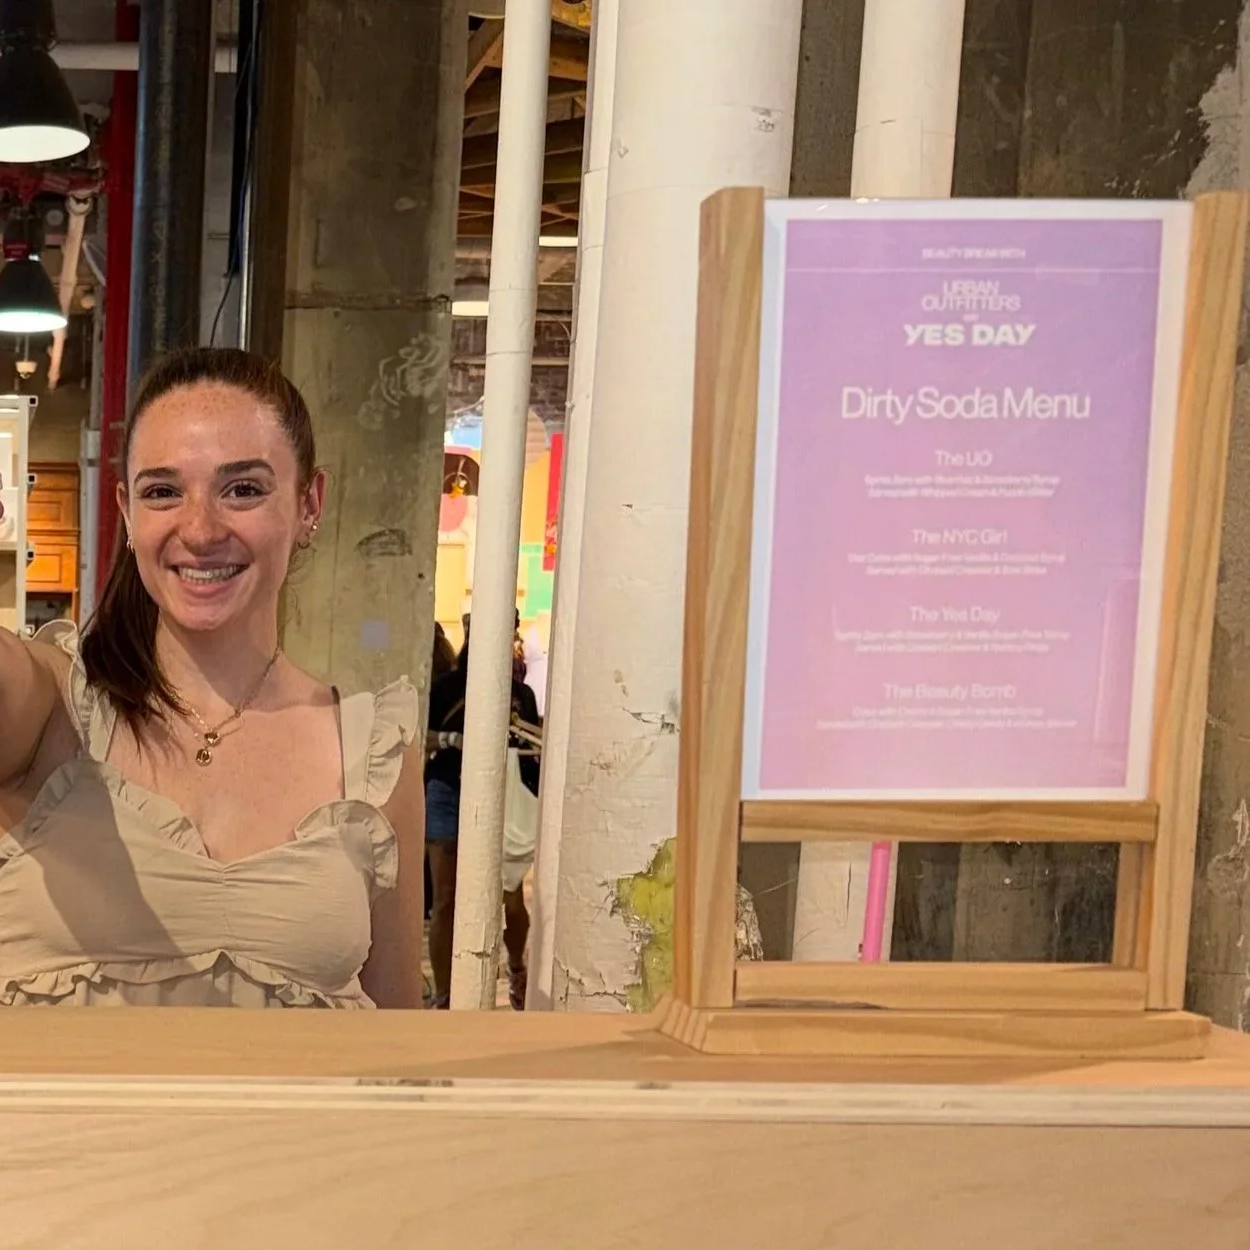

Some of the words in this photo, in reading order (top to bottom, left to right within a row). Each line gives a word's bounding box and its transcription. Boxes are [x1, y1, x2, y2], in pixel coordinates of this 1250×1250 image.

[943, 279, 1001, 296] URBAN
[921, 294, 1022, 312] OUTFITTERS
[903, 323, 965, 346] YES
[972, 323, 1037, 346] DAY
[841, 386, 914, 426] Dirty
[916, 386, 998, 420] Soda
[1001, 387, 1092, 420] Menu
[934, 448, 963, 467] The
[965, 448, 994, 467] UO
[911, 527, 940, 546] The
[942, 528, 978, 546] NYC
[980, 528, 1009, 546] Girl
[909, 604, 939, 623] The
[942, 604, 968, 623] Yes
[970, 604, 1001, 625] Day
[882, 682, 913, 700] The
[915, 682, 968, 701] Beauty
[970, 683, 1017, 700] Bomb
